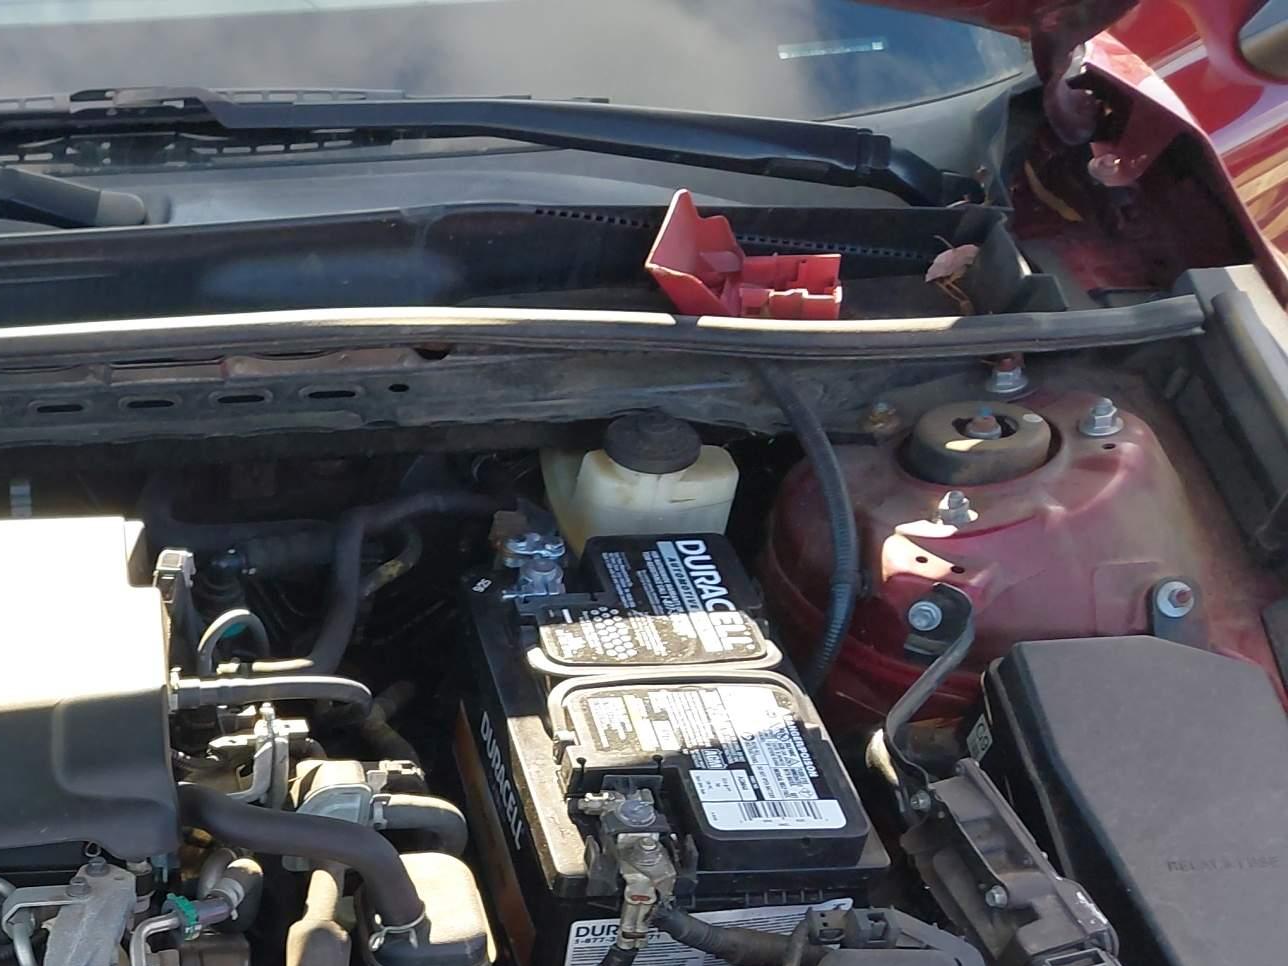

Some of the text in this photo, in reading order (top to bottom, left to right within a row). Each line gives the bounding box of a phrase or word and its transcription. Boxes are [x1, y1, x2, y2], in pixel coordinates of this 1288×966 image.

[667, 556, 701, 608] AUTOMOTIVE
[675, 539, 754, 651] DURACELL
[480, 711, 523, 851] DURACELL
